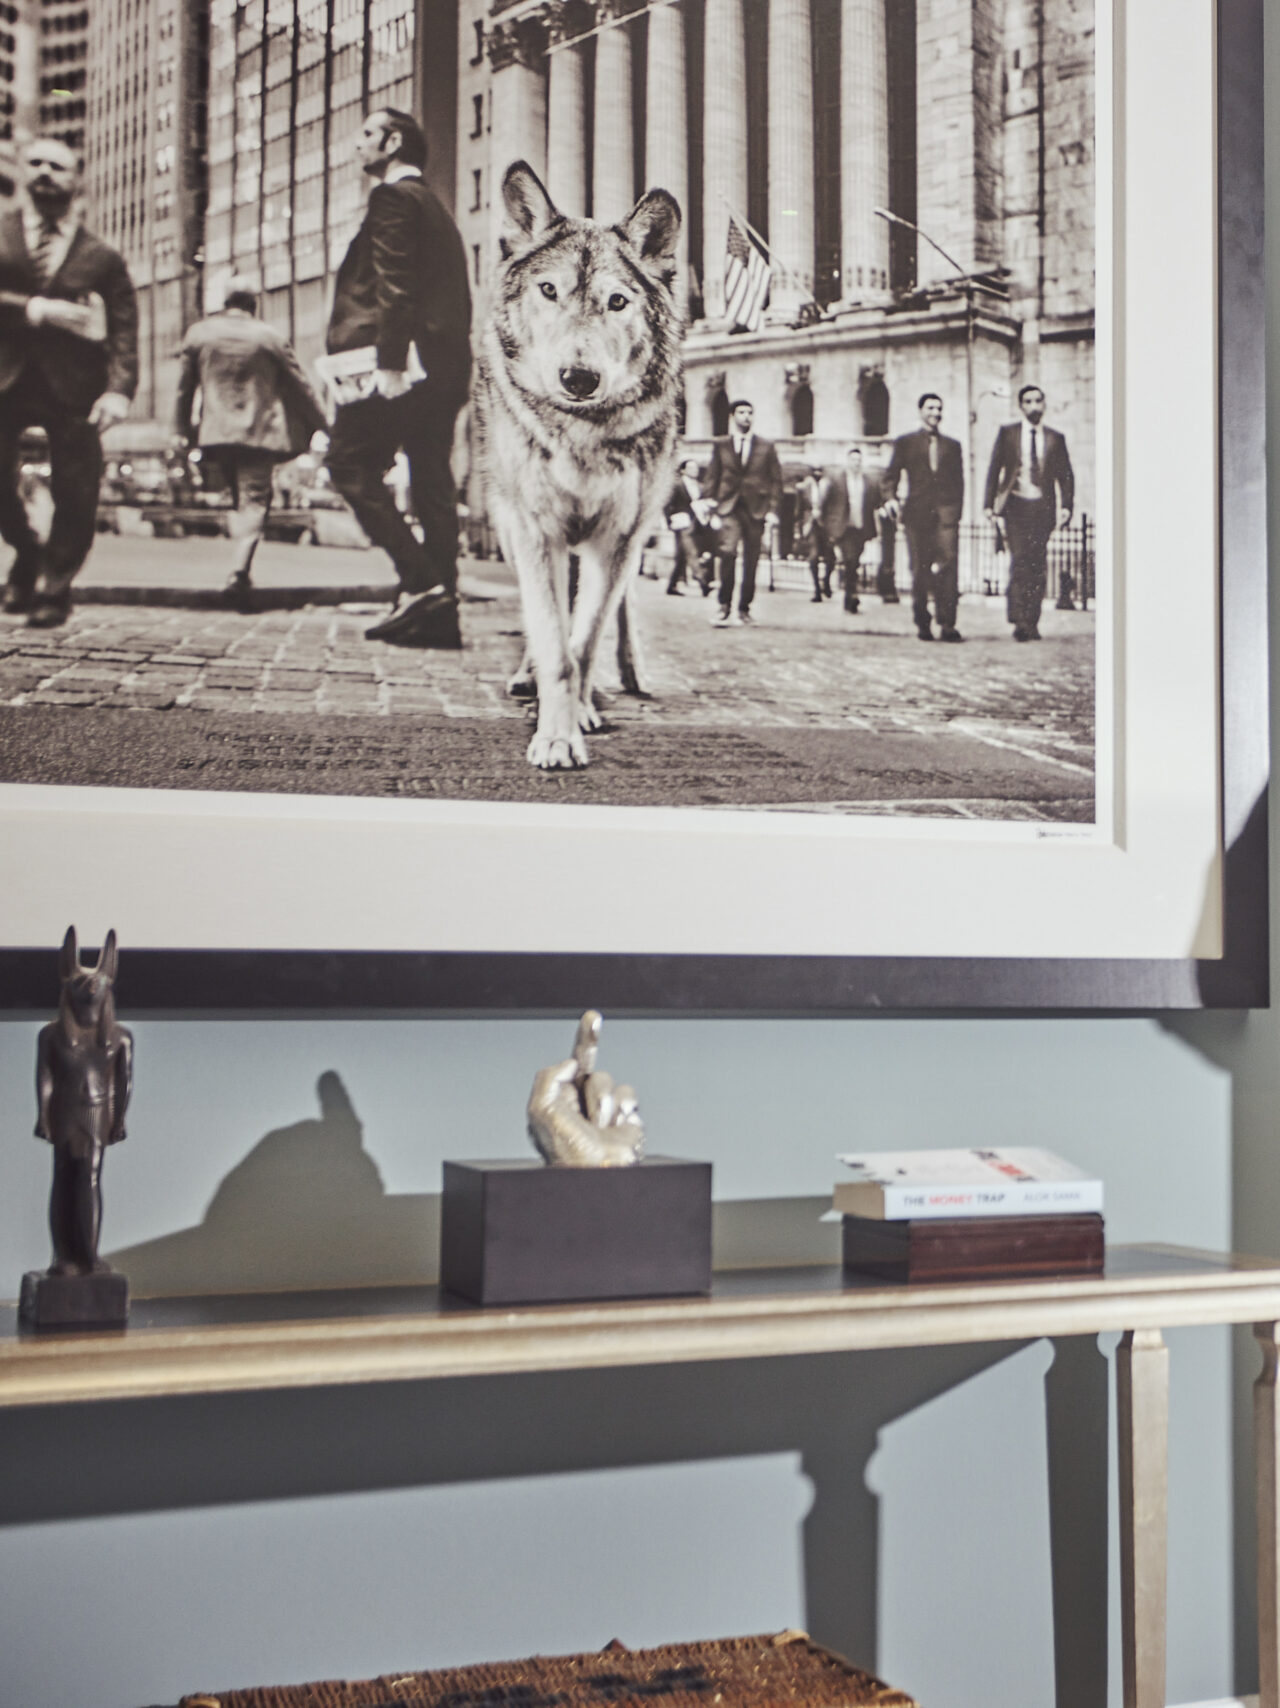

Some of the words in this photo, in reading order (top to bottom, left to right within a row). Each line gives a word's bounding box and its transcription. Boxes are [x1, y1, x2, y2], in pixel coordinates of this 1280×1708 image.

[904, 1195, 925, 1206] THE
[929, 1194, 973, 1206] MONEY
[977, 1193, 1006, 1205] TRAP
